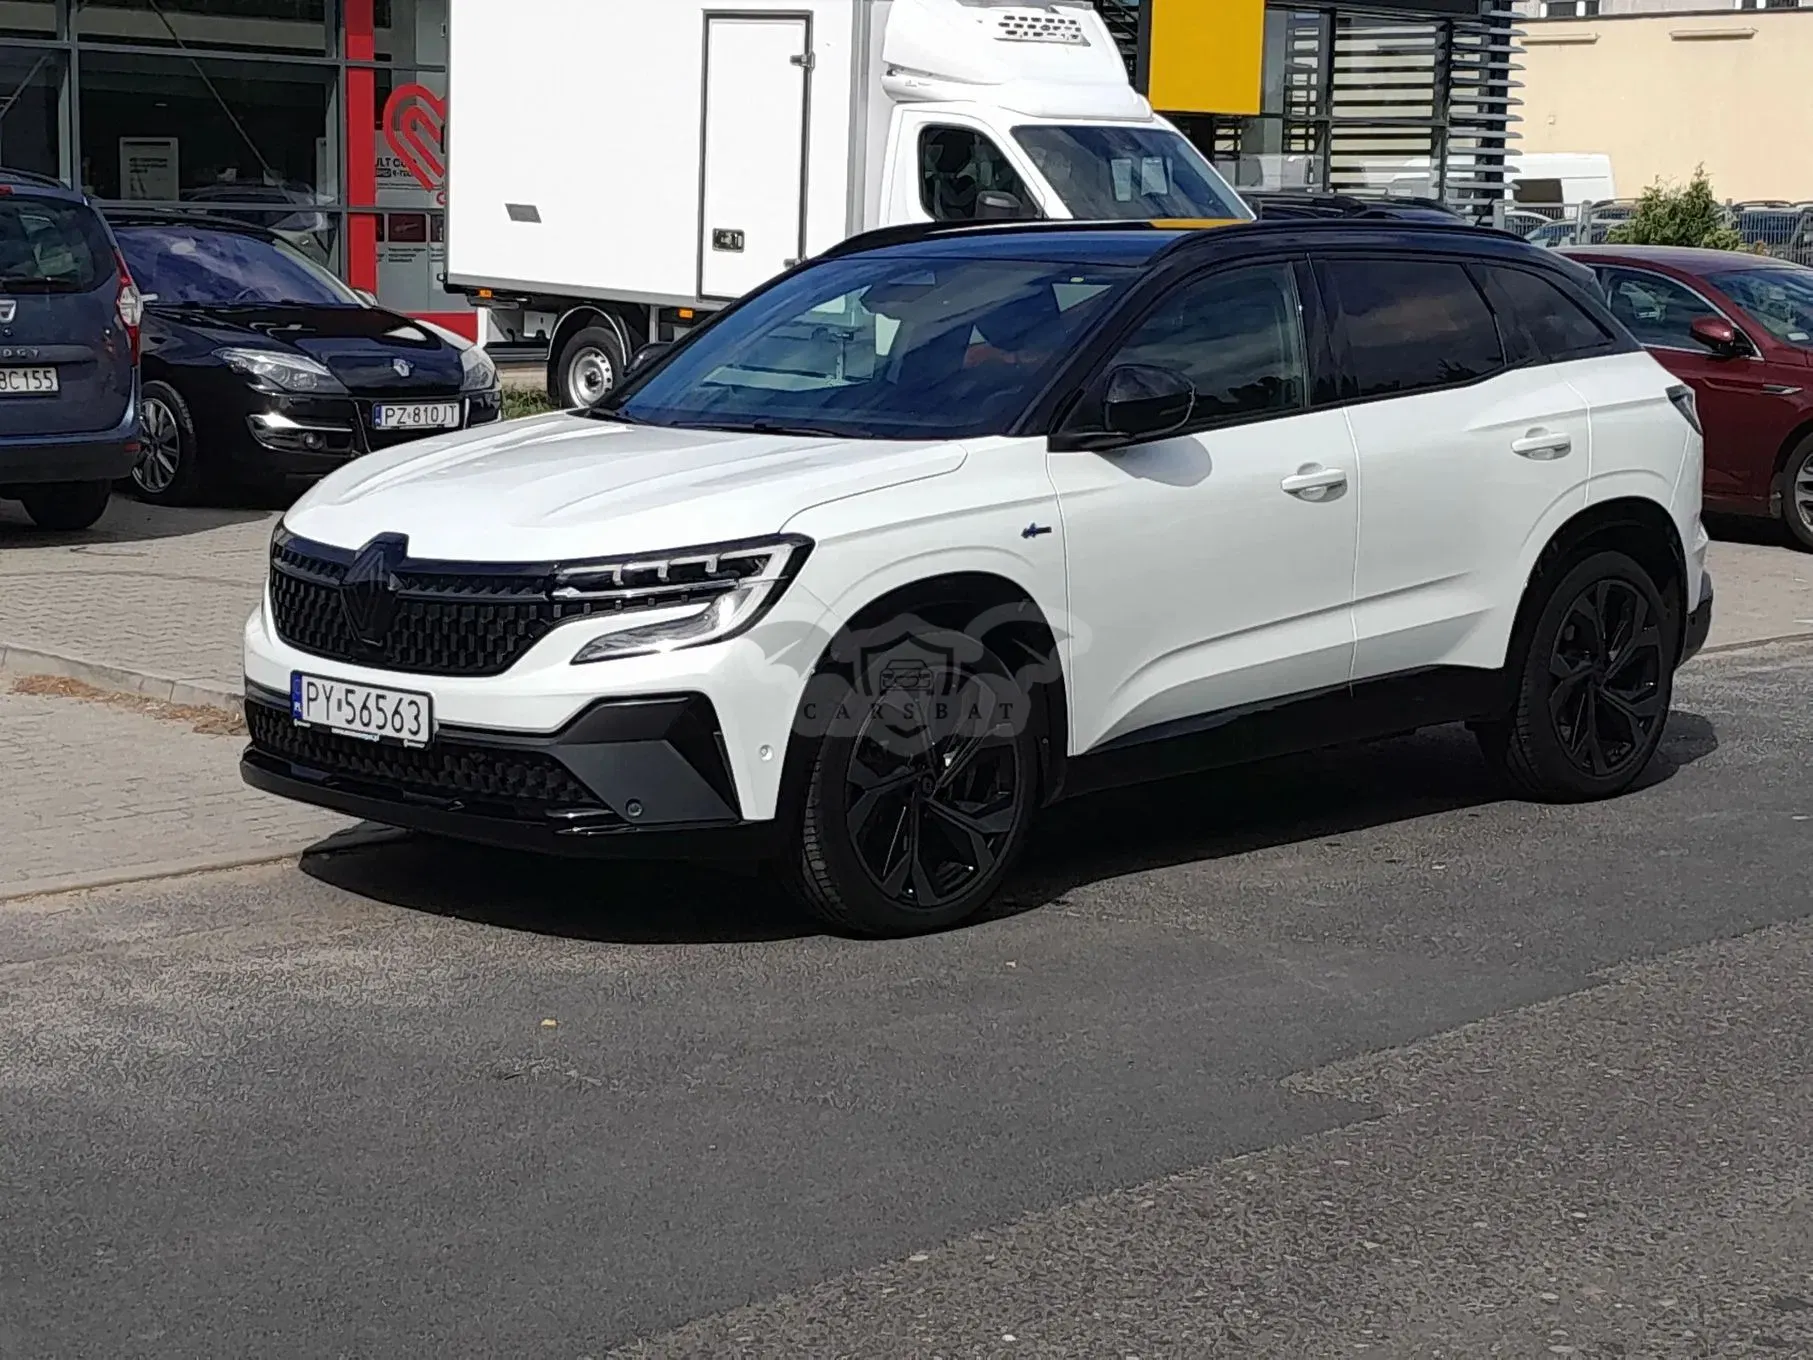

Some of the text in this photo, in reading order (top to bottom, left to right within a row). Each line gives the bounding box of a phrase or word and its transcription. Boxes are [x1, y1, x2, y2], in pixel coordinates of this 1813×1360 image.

[385, 405, 457, 424] PZ 810JT
[306, 681, 421, 736] PY 56563
